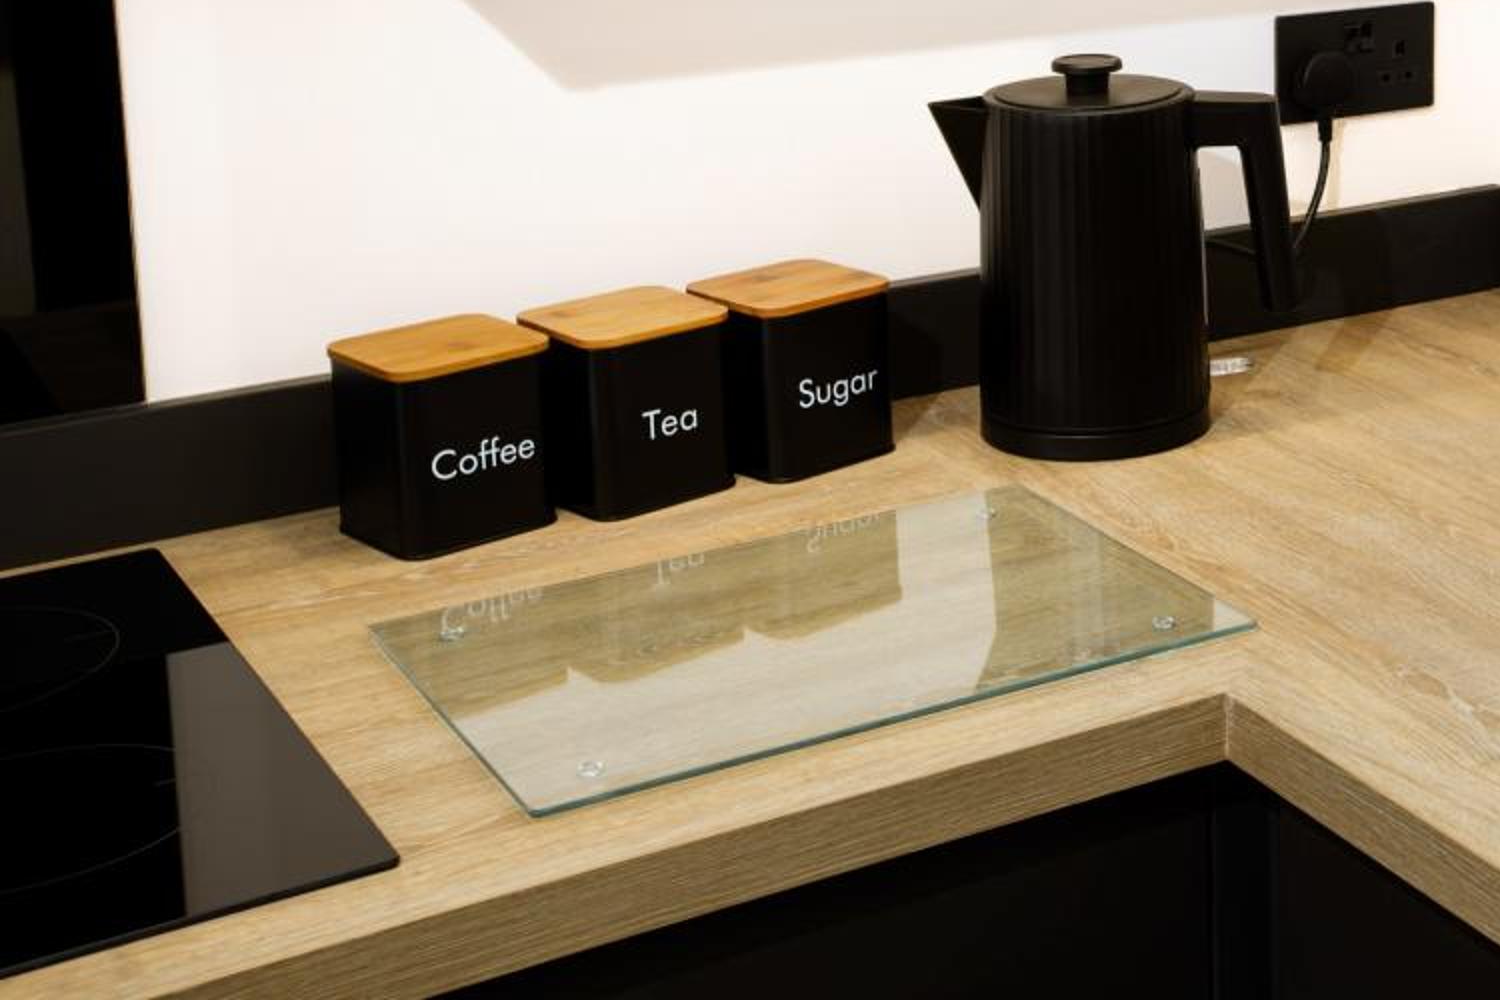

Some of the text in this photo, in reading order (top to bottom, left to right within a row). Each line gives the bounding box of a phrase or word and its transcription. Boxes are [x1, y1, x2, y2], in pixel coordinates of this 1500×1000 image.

[798, 369, 879, 408] Sugar
[642, 406, 699, 441] Tea
[430, 436, 536, 481] Coffee
